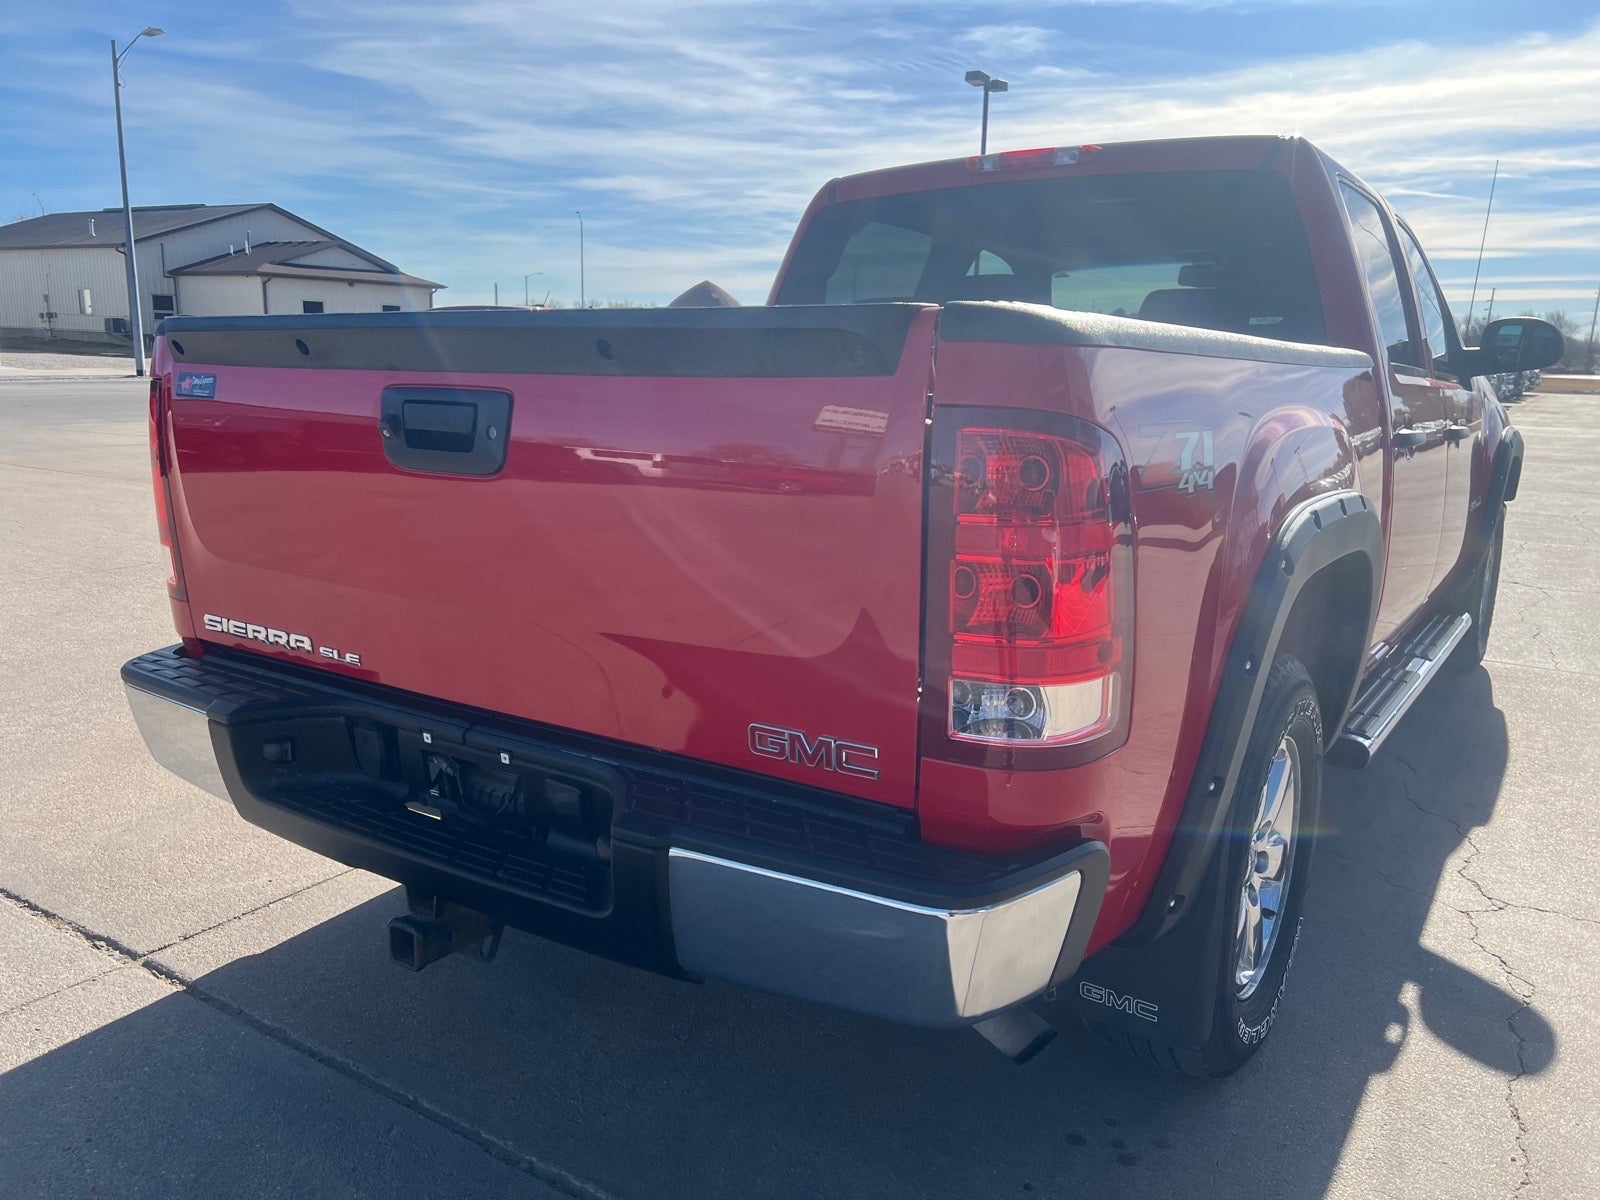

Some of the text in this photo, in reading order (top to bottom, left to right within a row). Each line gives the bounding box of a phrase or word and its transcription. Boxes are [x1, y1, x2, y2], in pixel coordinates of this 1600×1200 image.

[203, 613, 361, 666] SIERRA SLE
[748, 722, 879, 780] GMC
[1080, 981, 1158, 1022] GMC
